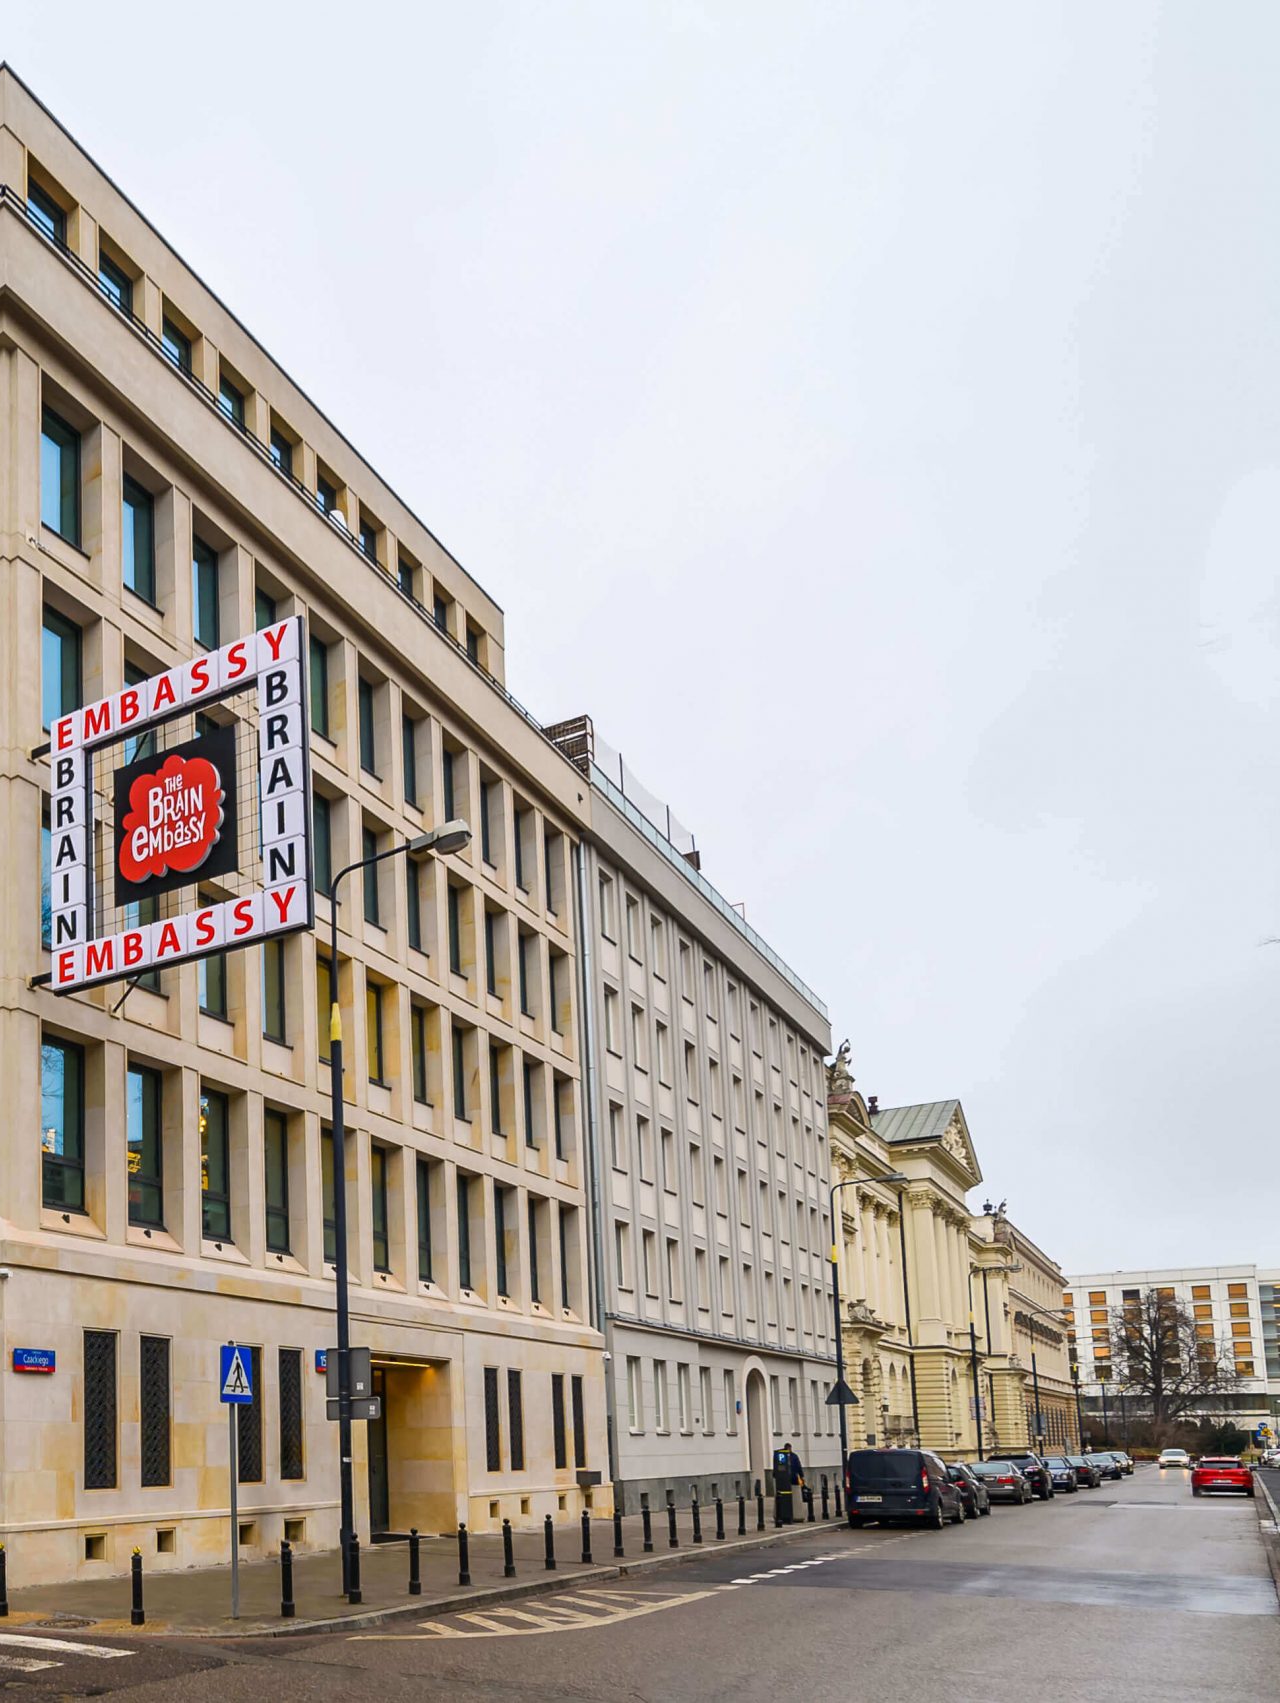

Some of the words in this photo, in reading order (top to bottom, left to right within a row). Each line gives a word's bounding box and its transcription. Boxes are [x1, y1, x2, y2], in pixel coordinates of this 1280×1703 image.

[57, 623, 288, 751] EMBASSY
[265, 669, 297, 882] BRAIN
[56, 757, 77, 945] BRAIN
[58, 886, 296, 984] EMBASSY
[23, 1354, 49, 1366] Czackiego
